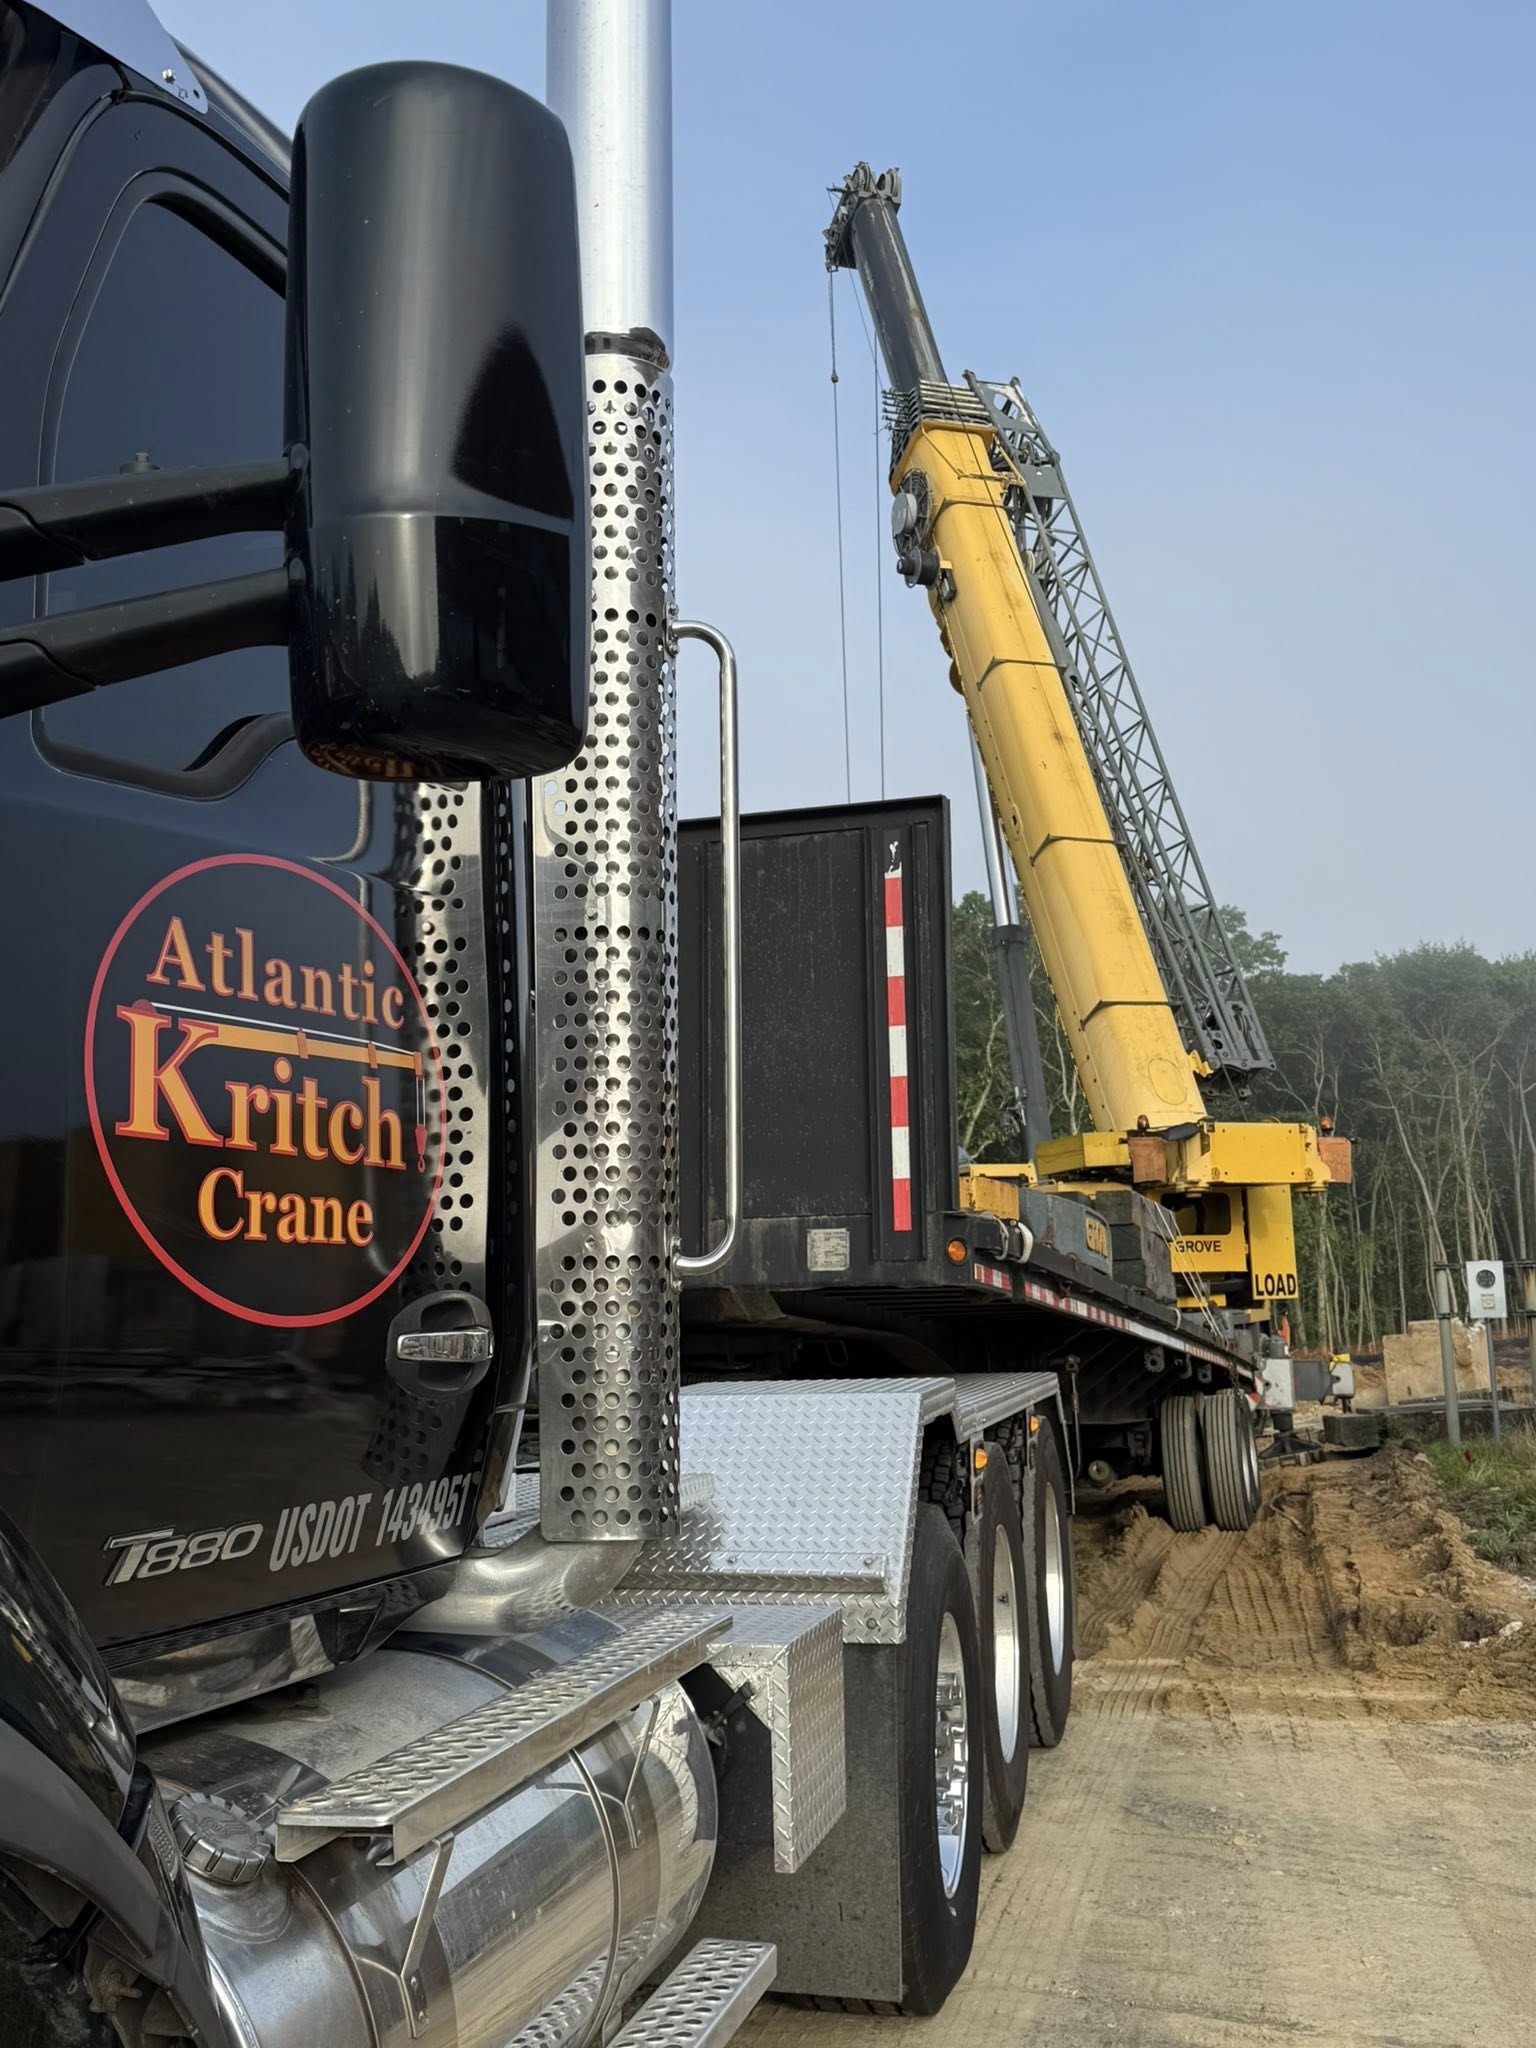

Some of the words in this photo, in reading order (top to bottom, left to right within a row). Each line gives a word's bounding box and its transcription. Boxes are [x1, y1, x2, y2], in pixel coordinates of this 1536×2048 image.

[146, 916, 405, 1030] Atlantic
[115, 1004, 407, 1171] Kritch
[198, 1167, 375, 1246] Crane
[1175, 1240, 1222, 1253] GROVE
[1254, 1273, 1297, 1296] LOAD
[103, 1521, 265, 1587] T880
[269, 1493, 373, 1573] USDOT
[375, 1472, 472, 1547] 1434951
